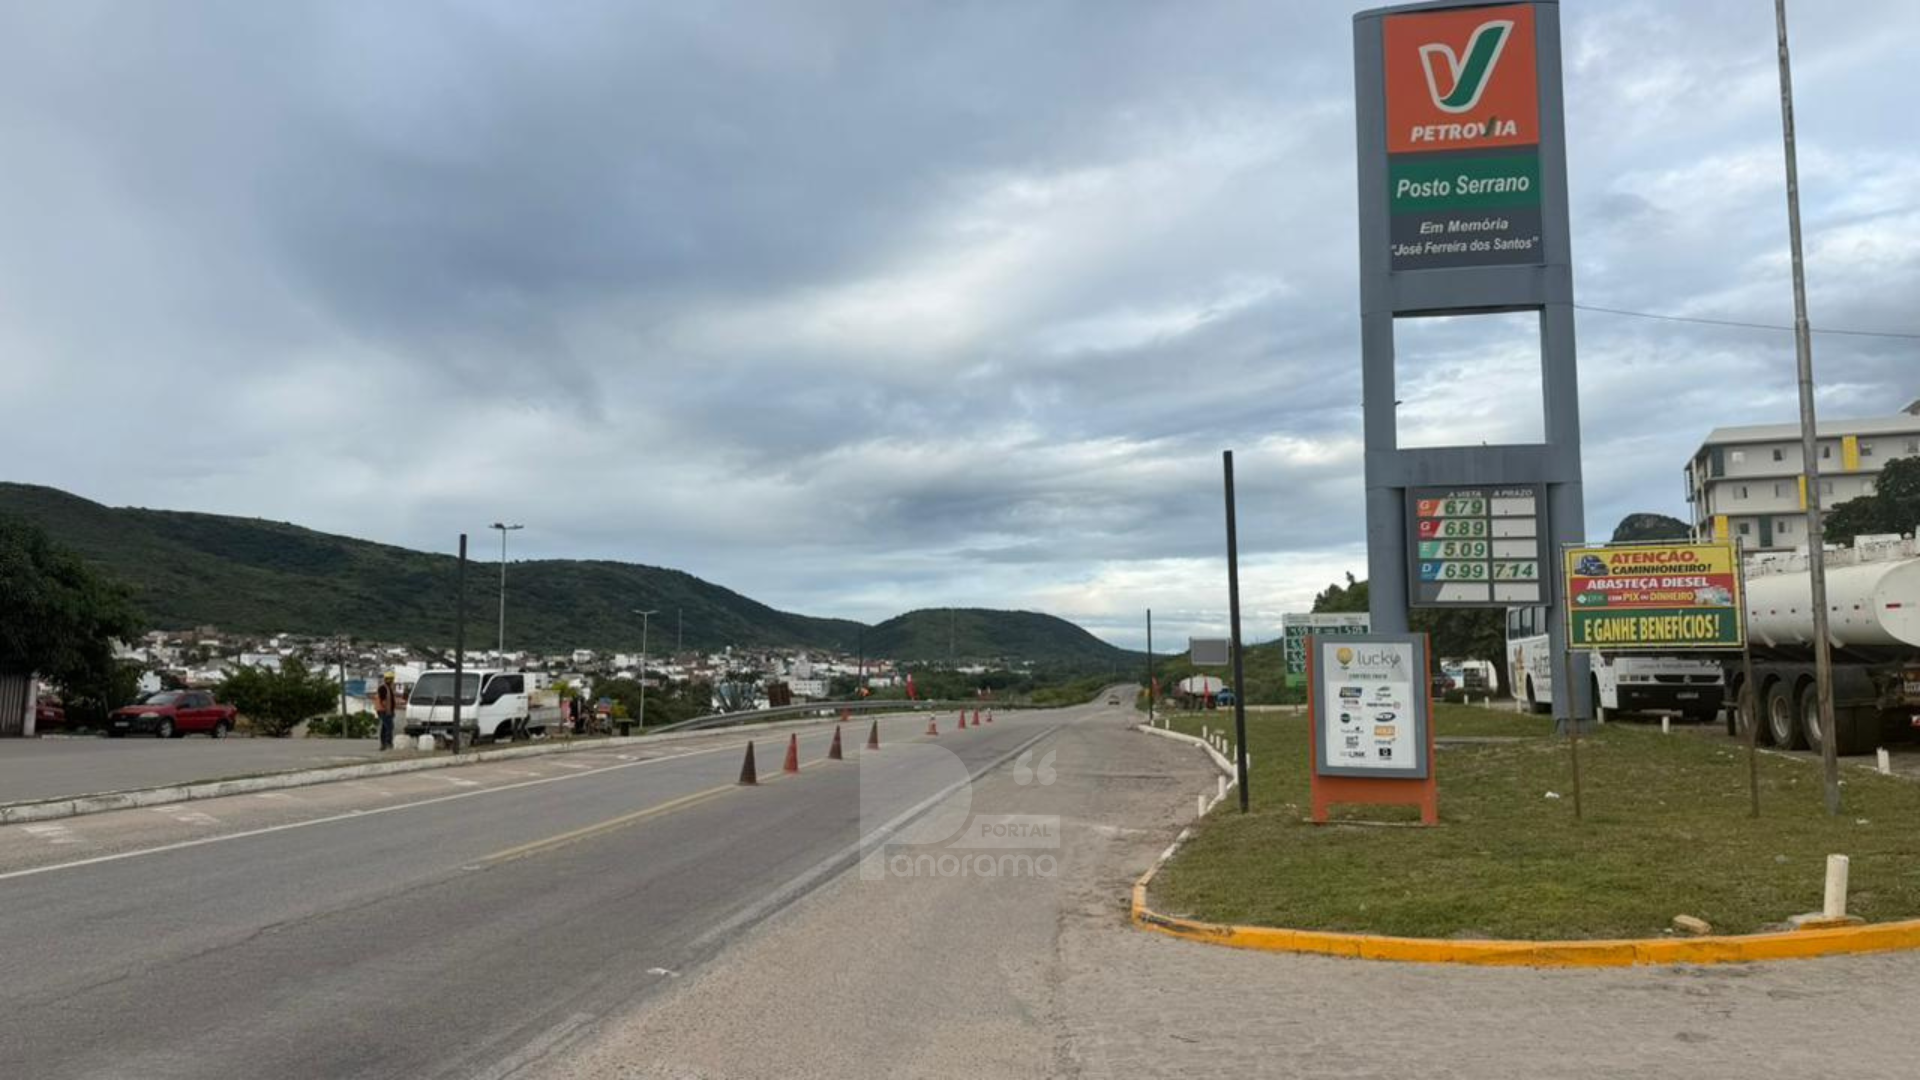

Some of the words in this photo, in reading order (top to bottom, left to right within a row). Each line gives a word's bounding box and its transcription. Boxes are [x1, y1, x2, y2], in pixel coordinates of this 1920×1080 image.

[1411, 117, 1517, 142] PETROVIA
[1397, 178, 1450, 198] Posto
[1456, 175, 1530, 195] Serrano
[1420, 221, 1444, 234] Em
[1448, 217, 1508, 233] Memória
[1425, 240, 1467, 254] Ferreira
[1470, 239, 1490, 252] dos
[1420, 521, 1431, 530] G
[1421, 564, 1431, 572] D
[1612, 564, 1712, 575] CAMINHONEIRO!
[1587, 578, 1658, 590] ABASTEÇA
[1662, 576, 1710, 588] DIESEL
[1584, 618, 1592, 642] E
[1594, 616, 1638, 641] GANHE
[1640, 609, 1719, 640] BENEFÍCIOS!
[1357, 650, 1401, 669] lucky
